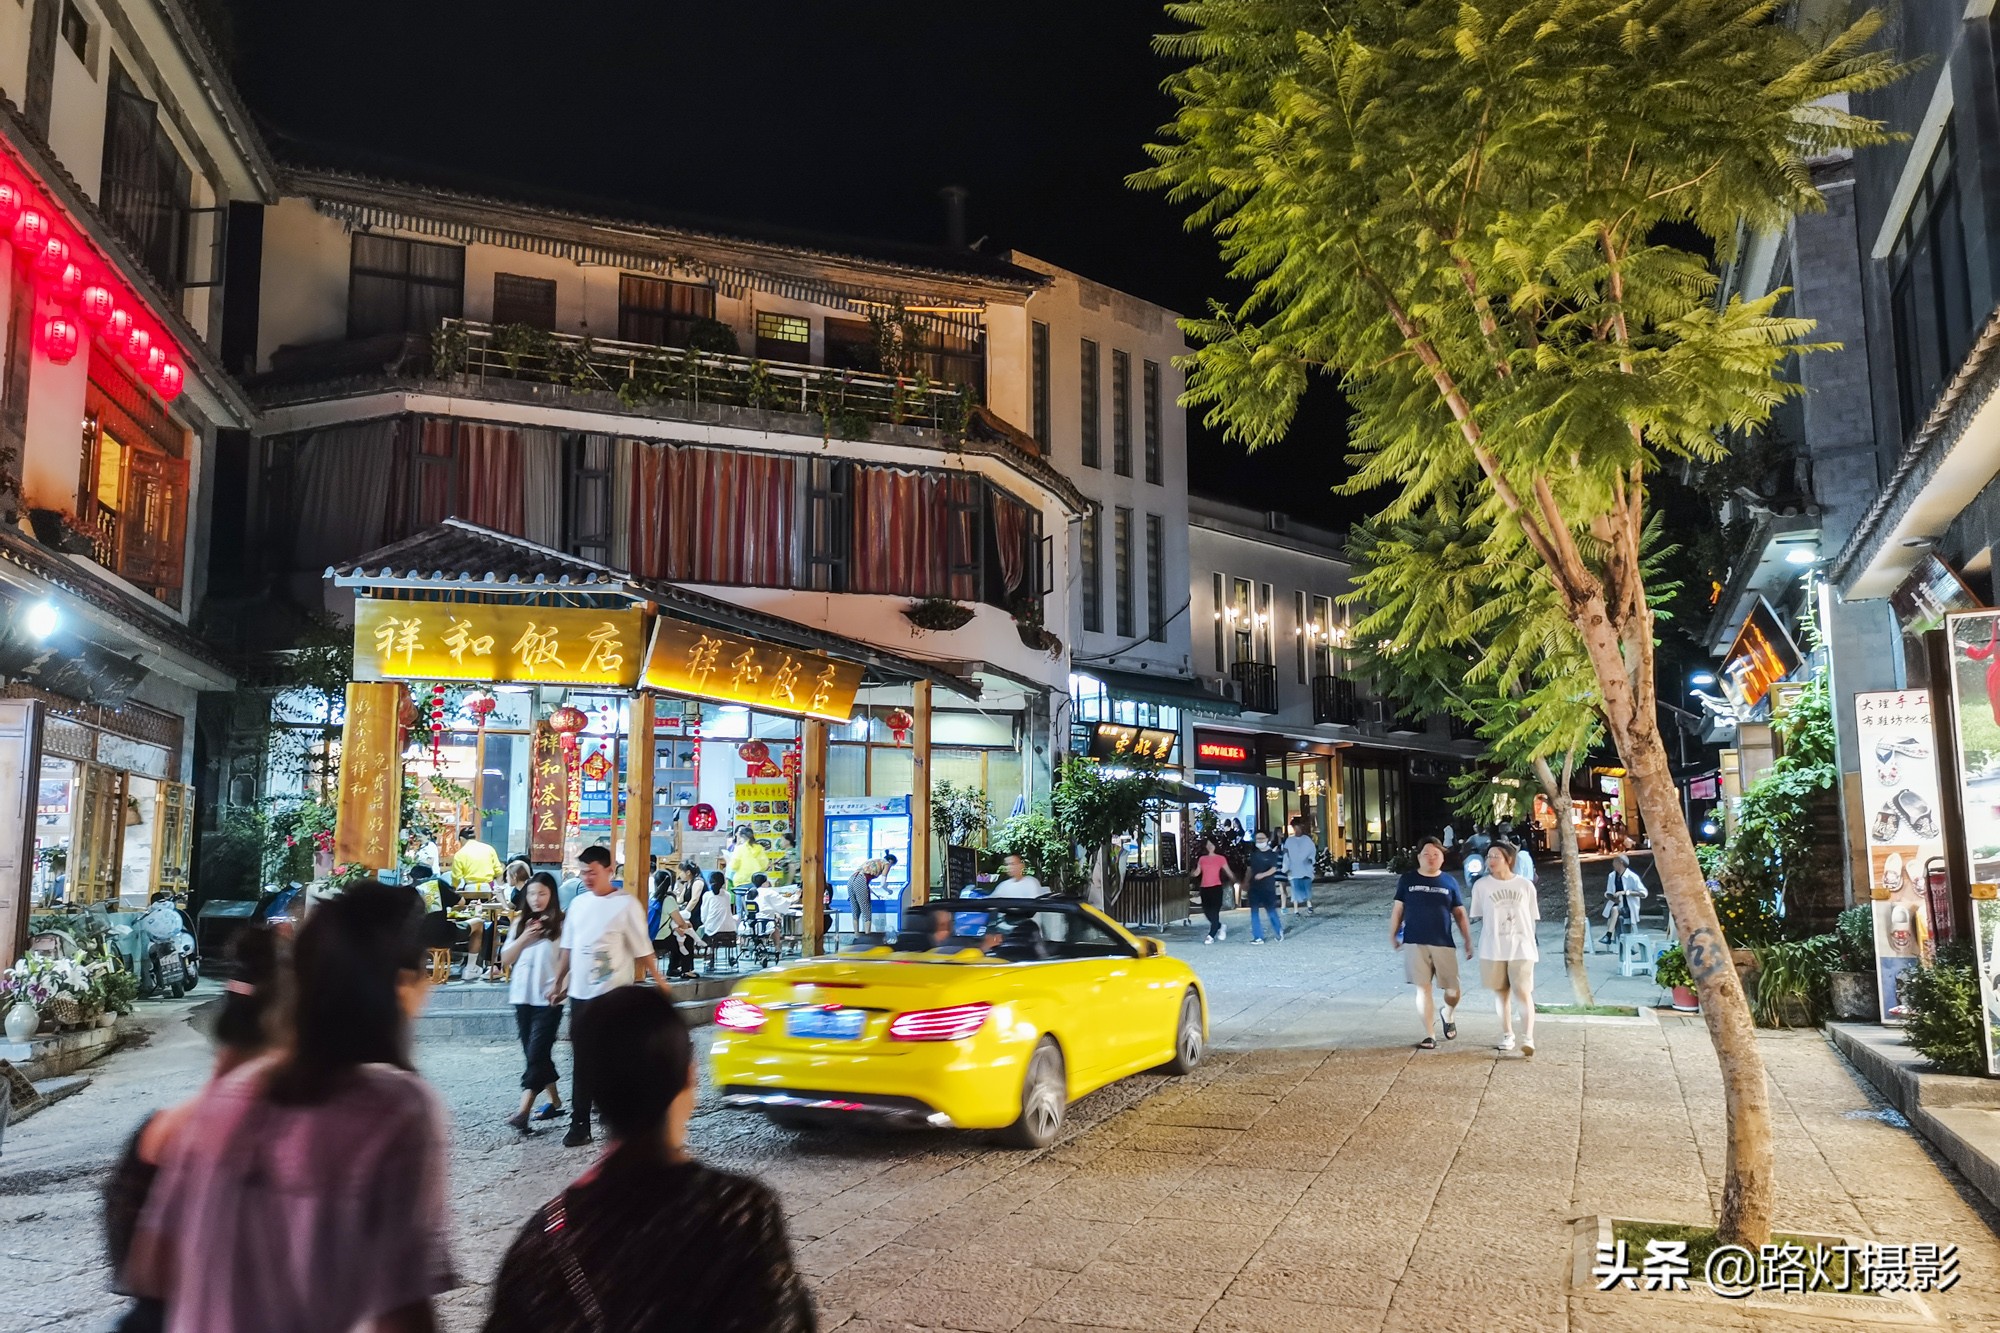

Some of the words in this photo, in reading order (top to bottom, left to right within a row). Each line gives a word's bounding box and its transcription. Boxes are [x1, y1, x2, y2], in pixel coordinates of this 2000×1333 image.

[374, 616, 624, 675] 祥和饭店
[686, 635, 836, 711] 祥和饭店
[1862, 694, 1928, 710] 大理手工
[537, 732, 561, 833] 祥和茶庄
